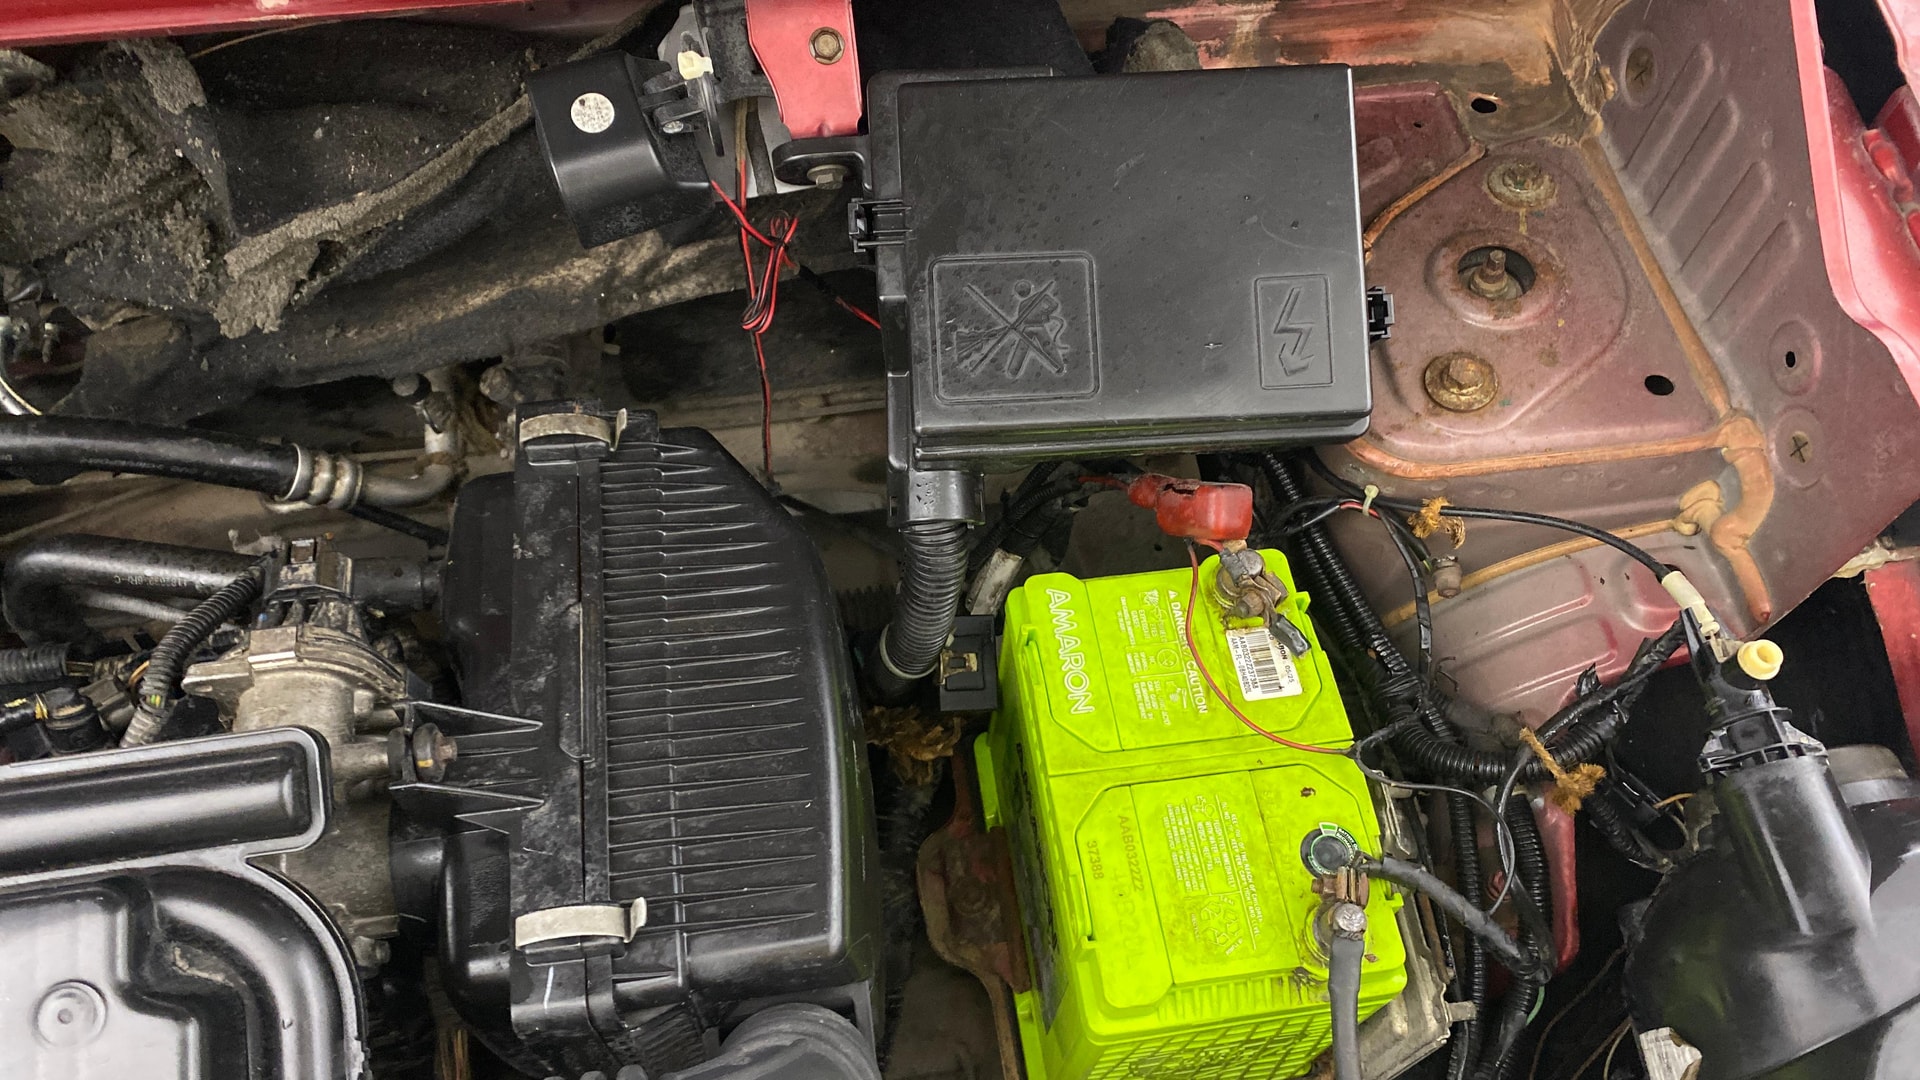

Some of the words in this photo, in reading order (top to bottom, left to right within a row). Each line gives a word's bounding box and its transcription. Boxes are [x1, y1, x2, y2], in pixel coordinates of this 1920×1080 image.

[1046, 588, 1095, 714] AMARON
[1171, 602, 1189, 650] DANGER
[1186, 659, 1208, 714] CAUTION
[1086, 840, 1105, 880] 37388
